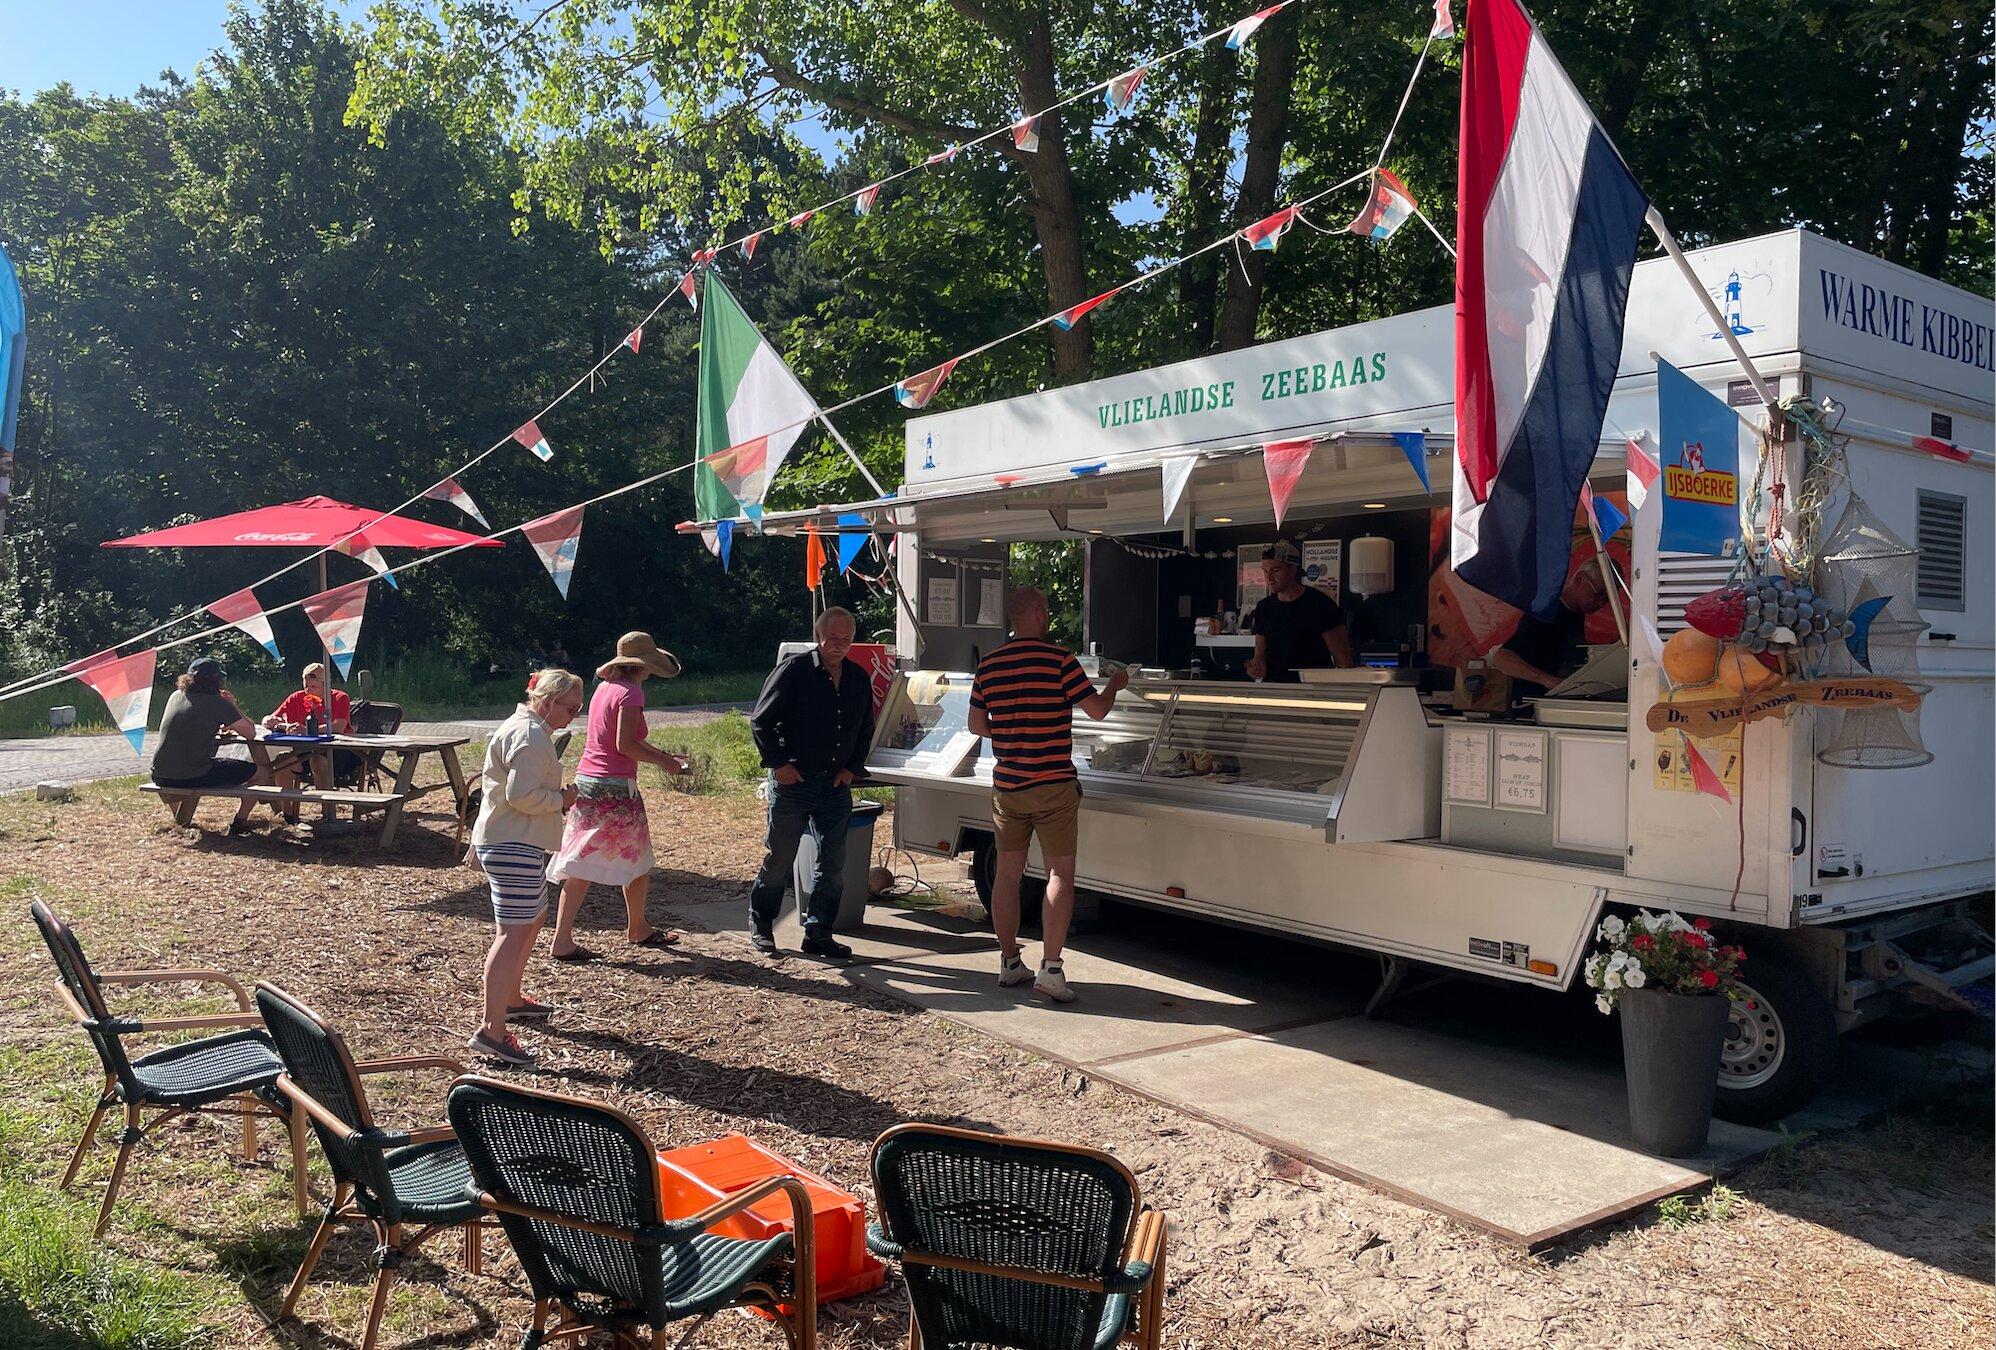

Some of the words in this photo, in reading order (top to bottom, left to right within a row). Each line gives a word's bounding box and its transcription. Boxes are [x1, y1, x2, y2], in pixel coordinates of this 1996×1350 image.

[1819, 268, 1914, 347] WARME
[1098, 380, 1235, 429] VLIELANDSE
[1262, 352, 1386, 401] ZEEBAAS
[1669, 472, 1734, 499] IJSBOERKE
